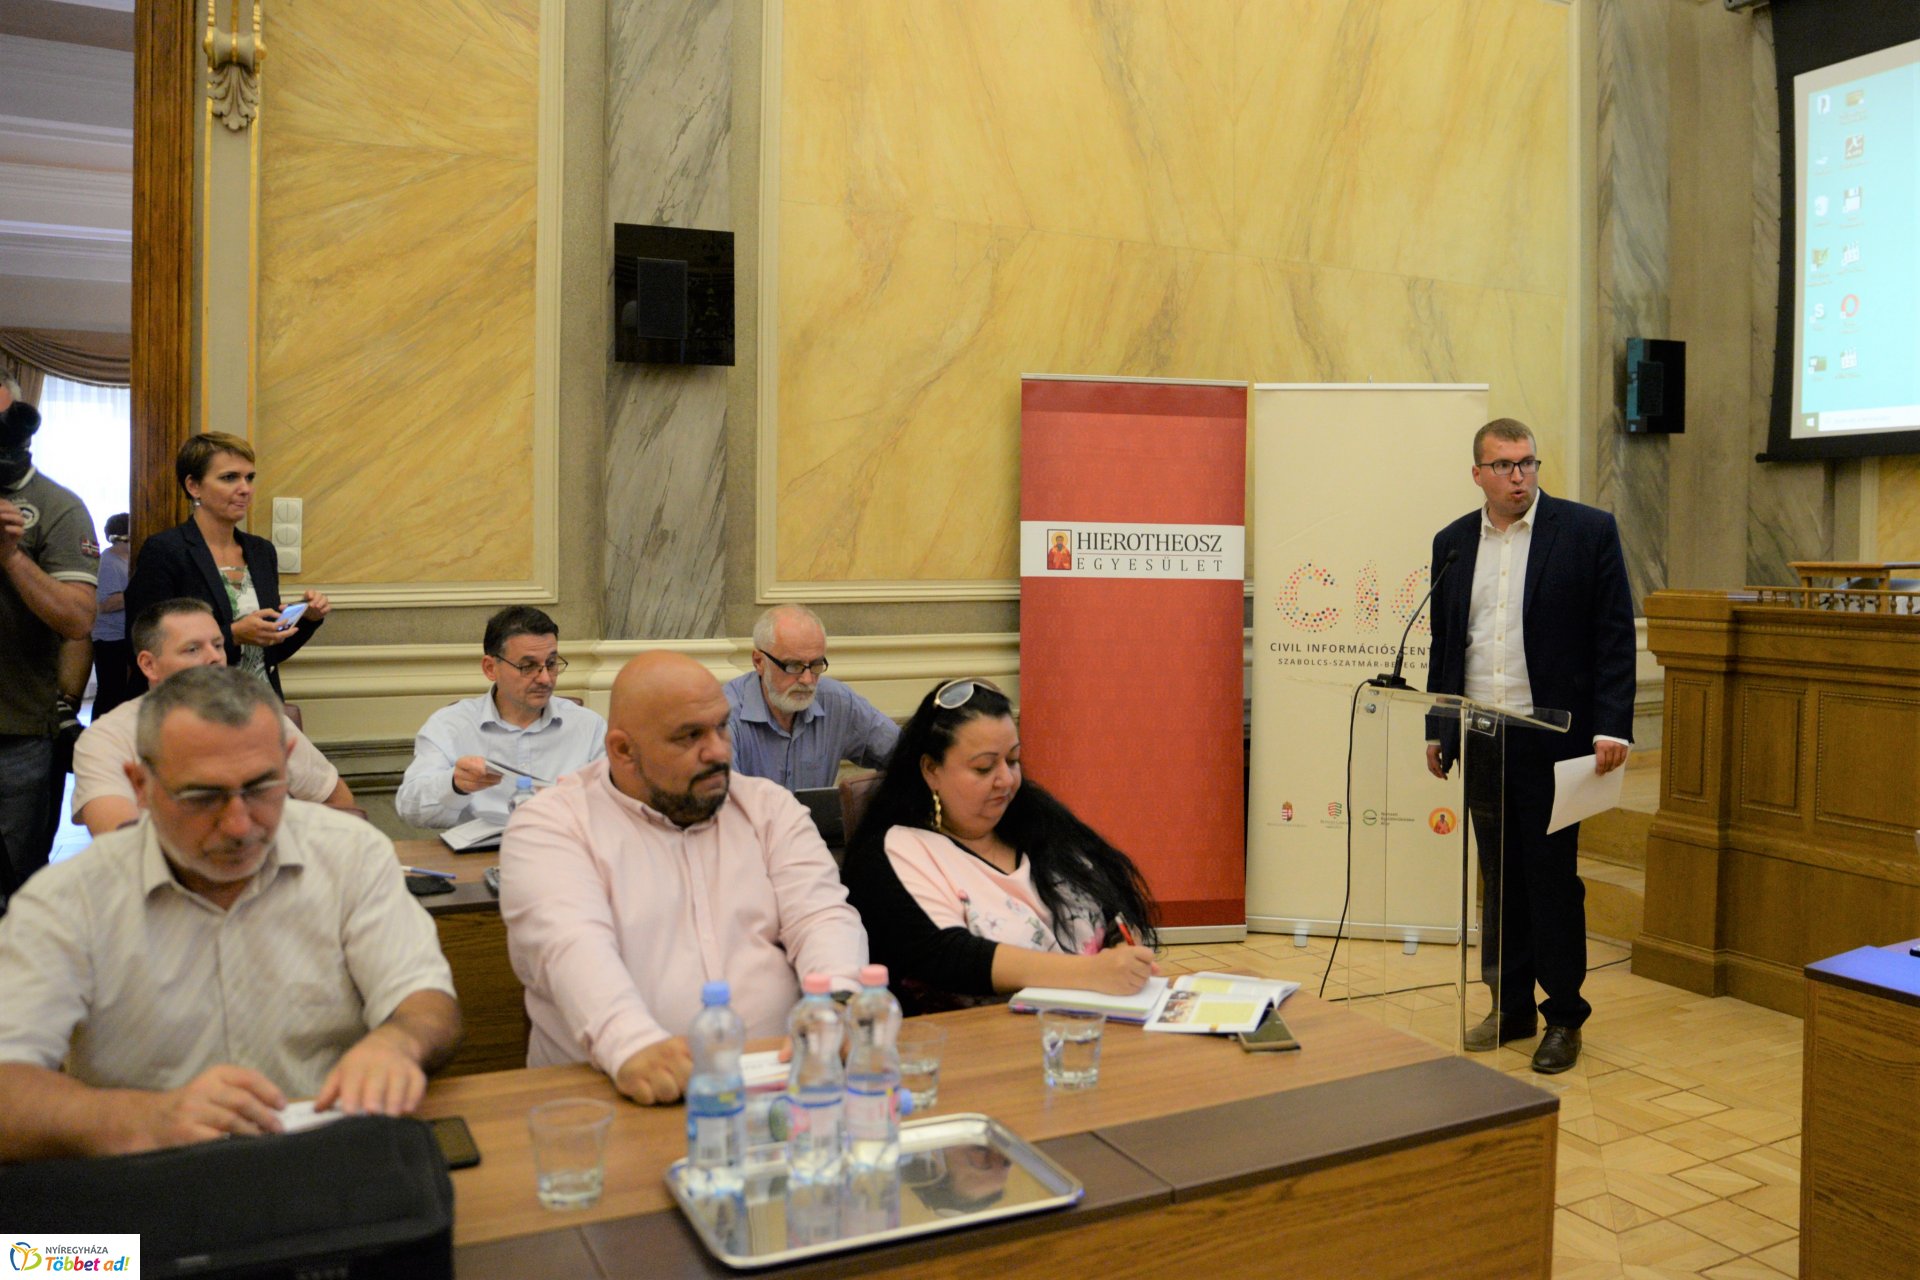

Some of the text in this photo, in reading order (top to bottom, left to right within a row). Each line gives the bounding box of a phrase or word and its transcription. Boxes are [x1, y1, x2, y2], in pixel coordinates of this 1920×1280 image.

[1077, 532, 1223, 553] HIEROTHEOSZ
[1077, 556, 1223, 572] EGYESÜLET
[1270, 642, 1301, 653] CIVIL
[1307, 643, 1397, 656] INFORMÁCIÓS
[1278, 658, 1415, 669] SZABOLCS-SZATMÁR-BEEG
